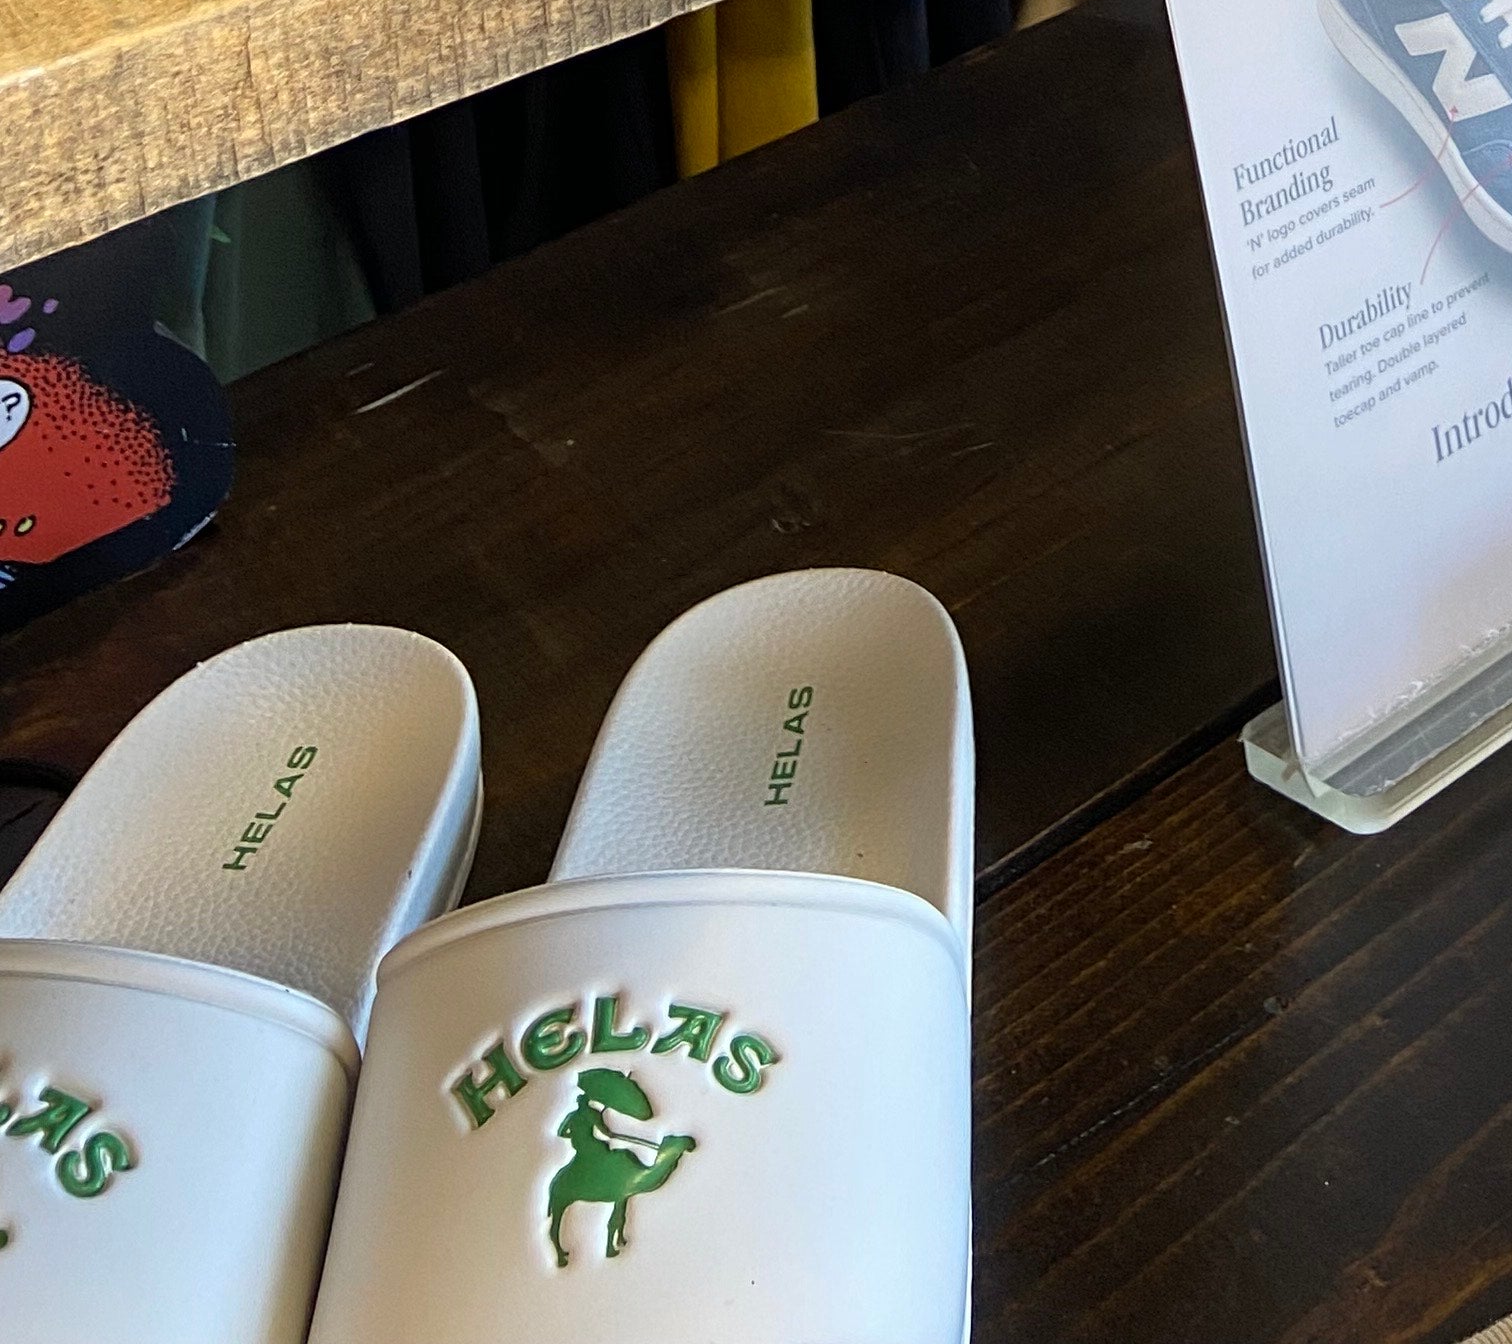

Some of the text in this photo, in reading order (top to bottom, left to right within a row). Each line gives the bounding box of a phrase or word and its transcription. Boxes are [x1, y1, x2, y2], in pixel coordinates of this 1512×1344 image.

[1233, 115, 1340, 192] Functional
[1239, 164, 1335, 227] Branding
[1267, 219, 1296, 243] logo
[1298, 196, 1341, 226] covers
[1342, 177, 1377, 203] seam
[1252, 206, 1375, 280] for added durability.
[1318, 281, 1413, 351] Durability
[1324, 271, 1491, 376] Taller toe cap line to prevent
[1328, 311, 1468, 404] tearing. Double layered
[1333, 359, 1440, 429] toecap and vamp.
[761, 684, 815, 807] HELAS
[222, 743, 320, 872] HELAS
[450, 994, 781, 1132] HELAS
